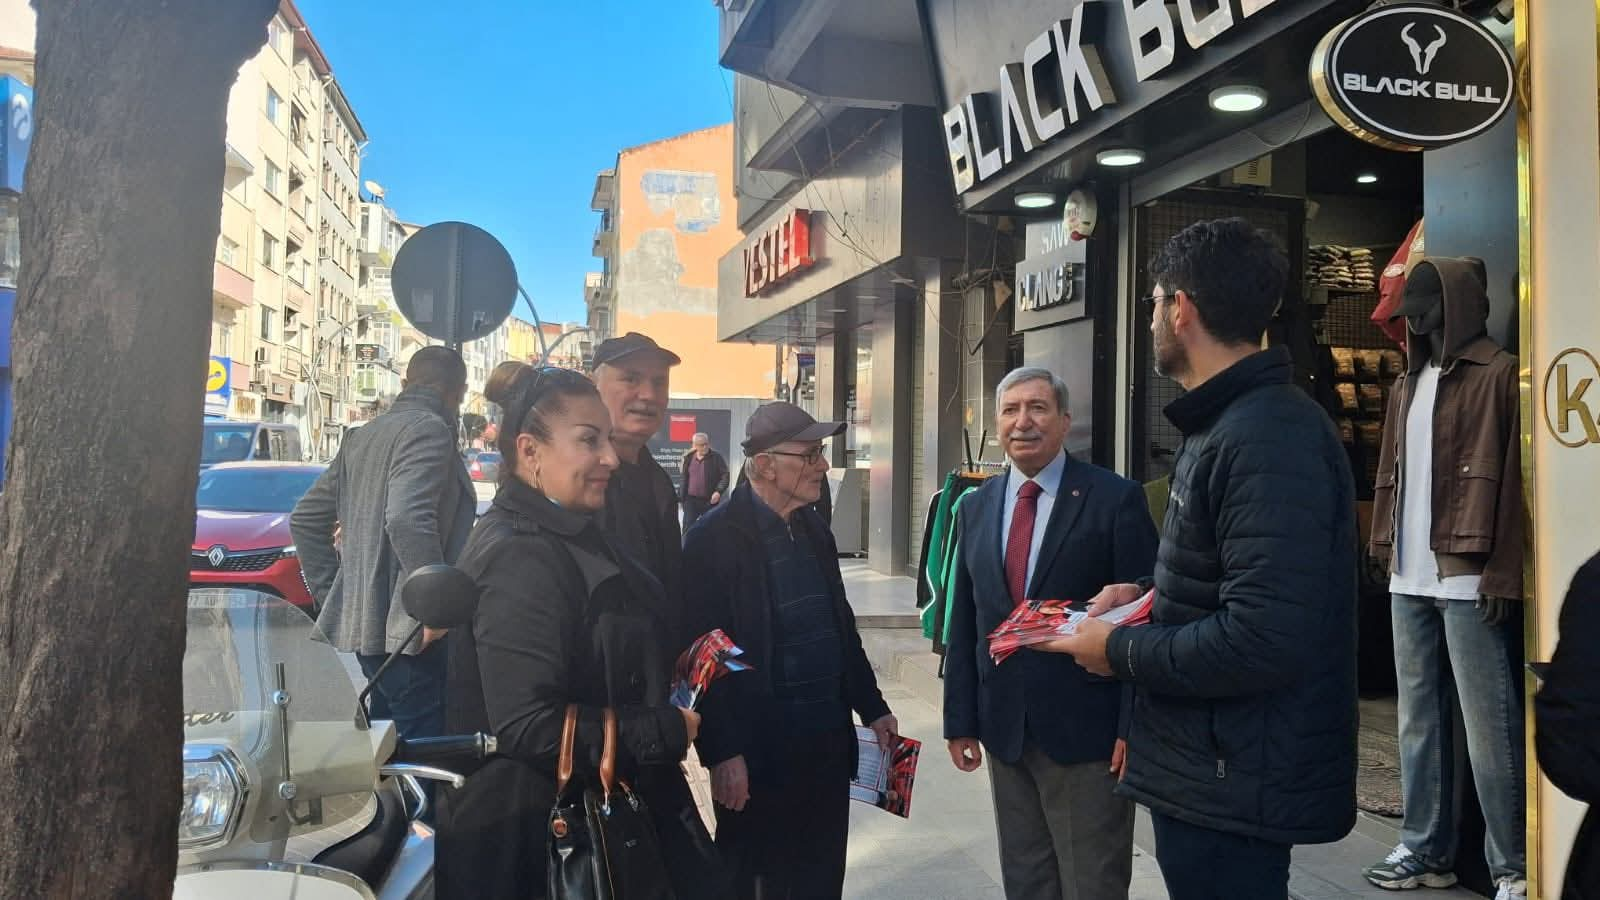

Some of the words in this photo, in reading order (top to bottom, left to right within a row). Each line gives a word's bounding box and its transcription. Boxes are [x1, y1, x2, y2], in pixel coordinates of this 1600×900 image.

[942, 1, 1104, 195] BLACK
[1343, 73, 1431, 98] BLACK
[1435, 82, 1501, 104] BULL
[744, 208, 802, 297] VESTEL
